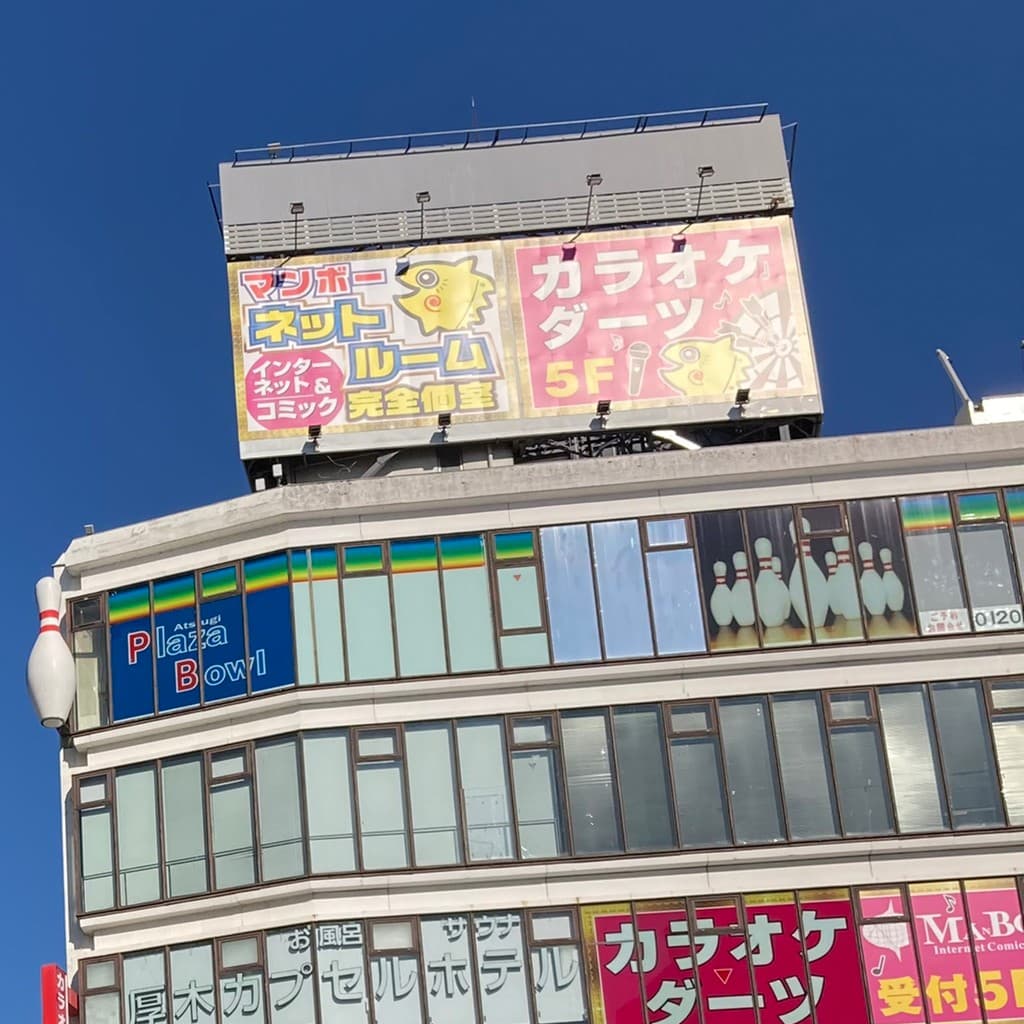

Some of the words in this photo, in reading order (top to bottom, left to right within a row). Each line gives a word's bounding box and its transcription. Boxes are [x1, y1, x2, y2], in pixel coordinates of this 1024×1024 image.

[241, 263, 387, 301] マンボー
[532, 239, 770, 301] カラオケ
[249, 300, 386, 347] ネット
[539, 298, 704, 350] ダーツ
[253, 357, 332, 376] インター
[347, 333, 496, 385] ルーム
[545, 357, 615, 398] 5F
[256, 397, 337, 421] コミック
[347, 381, 497, 421] 完全個室
[174, 614, 222, 632] Atsugi
[975, 609, 1021, 627] 0120
[128, 624, 228, 665] Plaza
[175, 649, 266, 694] Bowl
[288, 923, 364, 954] お風呂
[443, 914, 521, 942] サウナ
[604, 910, 847, 975] カラオケ
